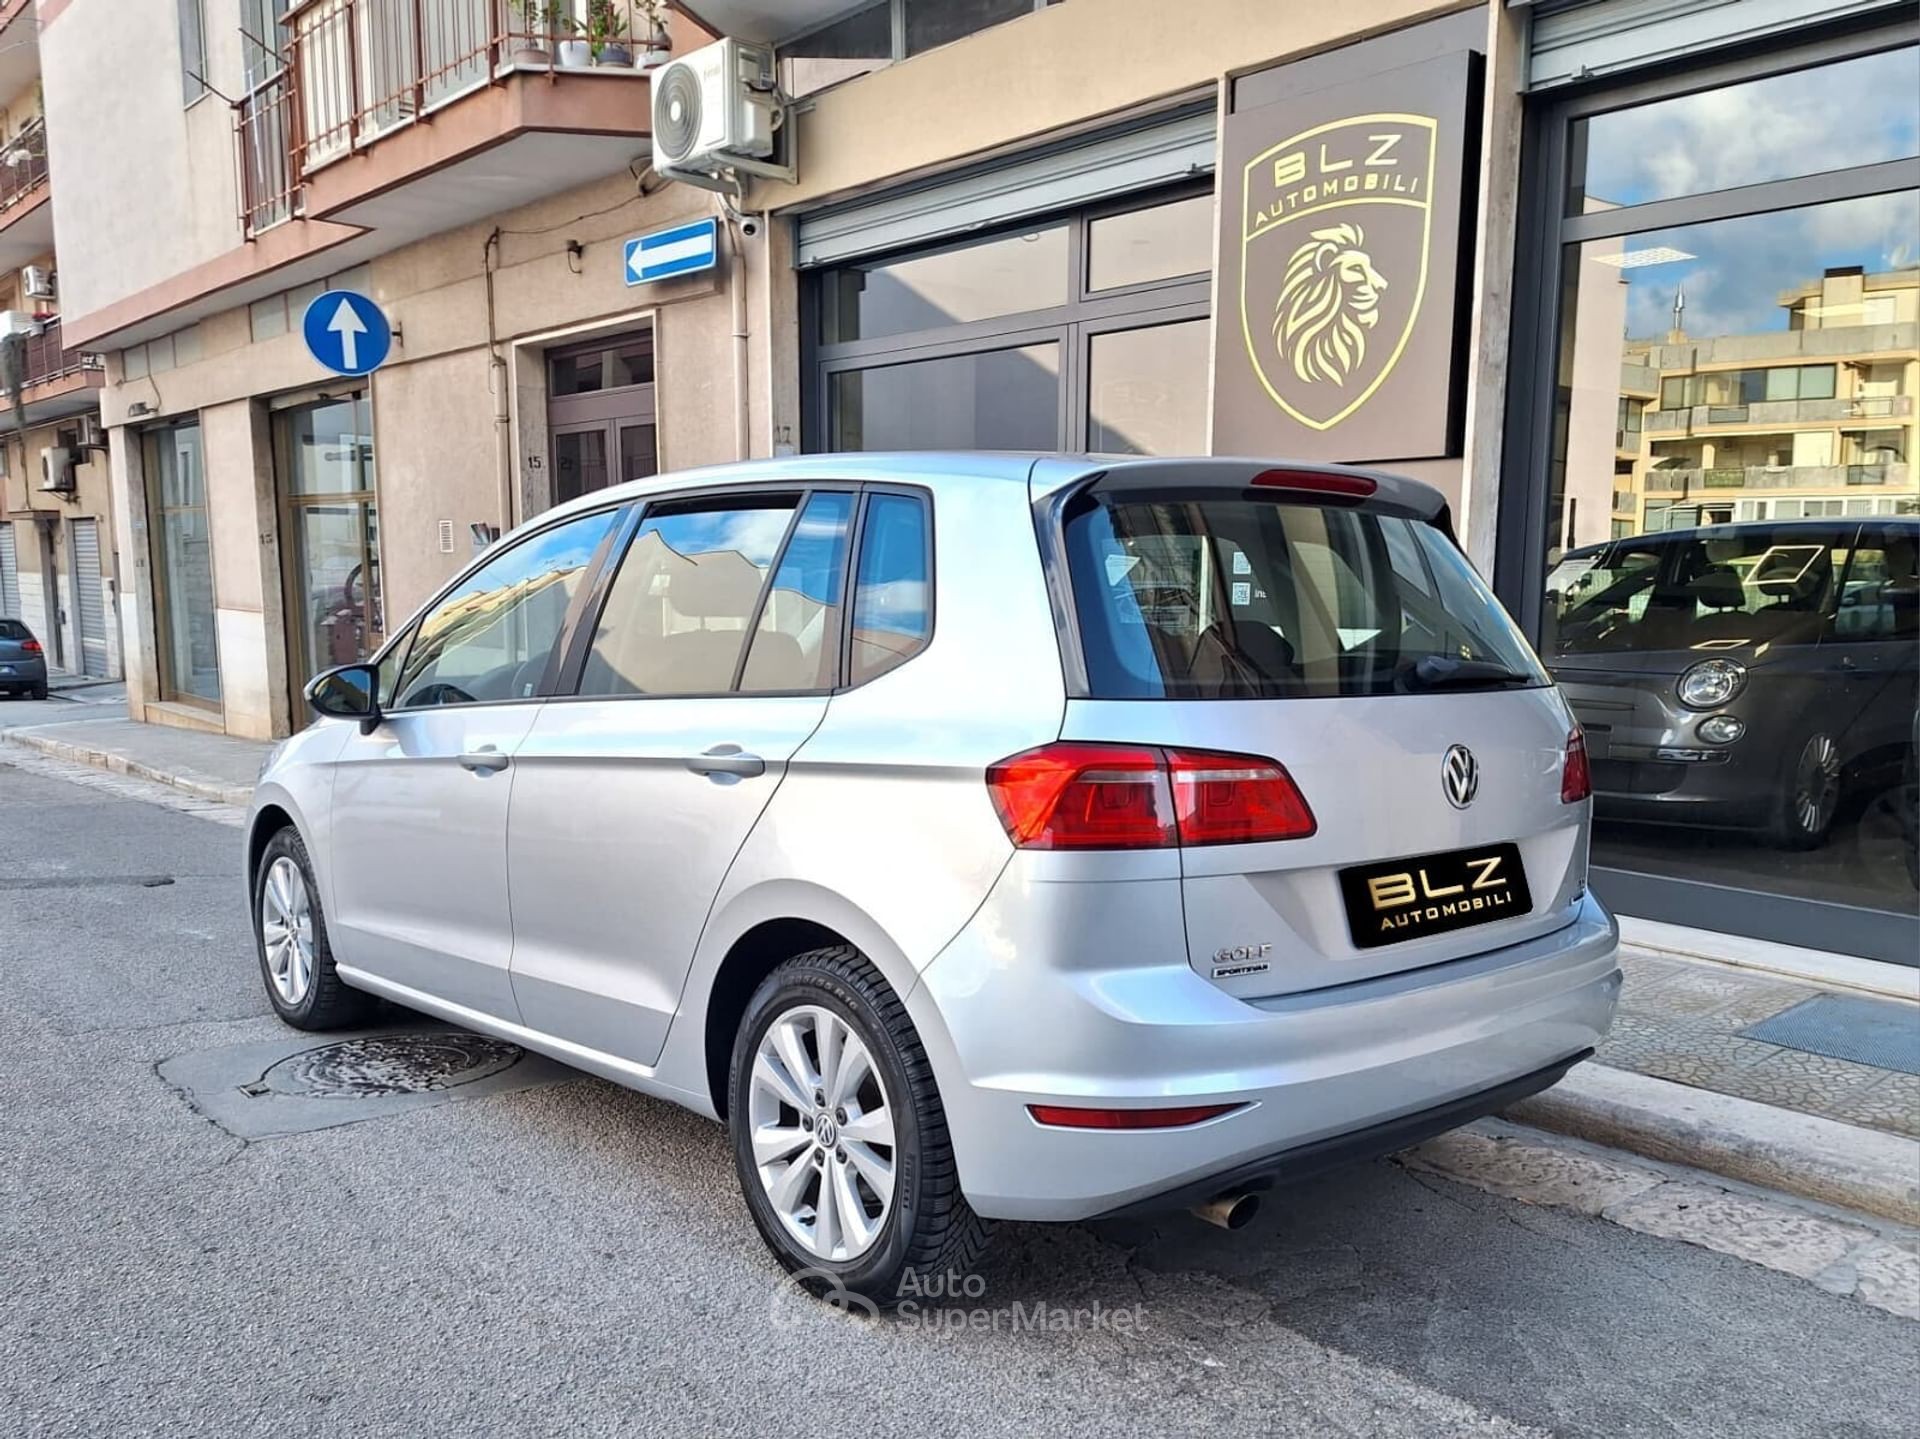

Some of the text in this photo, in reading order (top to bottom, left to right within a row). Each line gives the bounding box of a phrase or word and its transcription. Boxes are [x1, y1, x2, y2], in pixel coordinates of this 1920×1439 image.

[1274, 134, 1402, 187] BLZ
[1255, 173, 1418, 227] AUTOMOBILI
[528, 456, 541, 469] 15
[1368, 856, 1507, 910] BLZ
[1380, 891, 1512, 931] AUTOMOBILI
[1213, 944, 1272, 963] GOLF
[1216, 964, 1269, 976] SPORTSVAN
